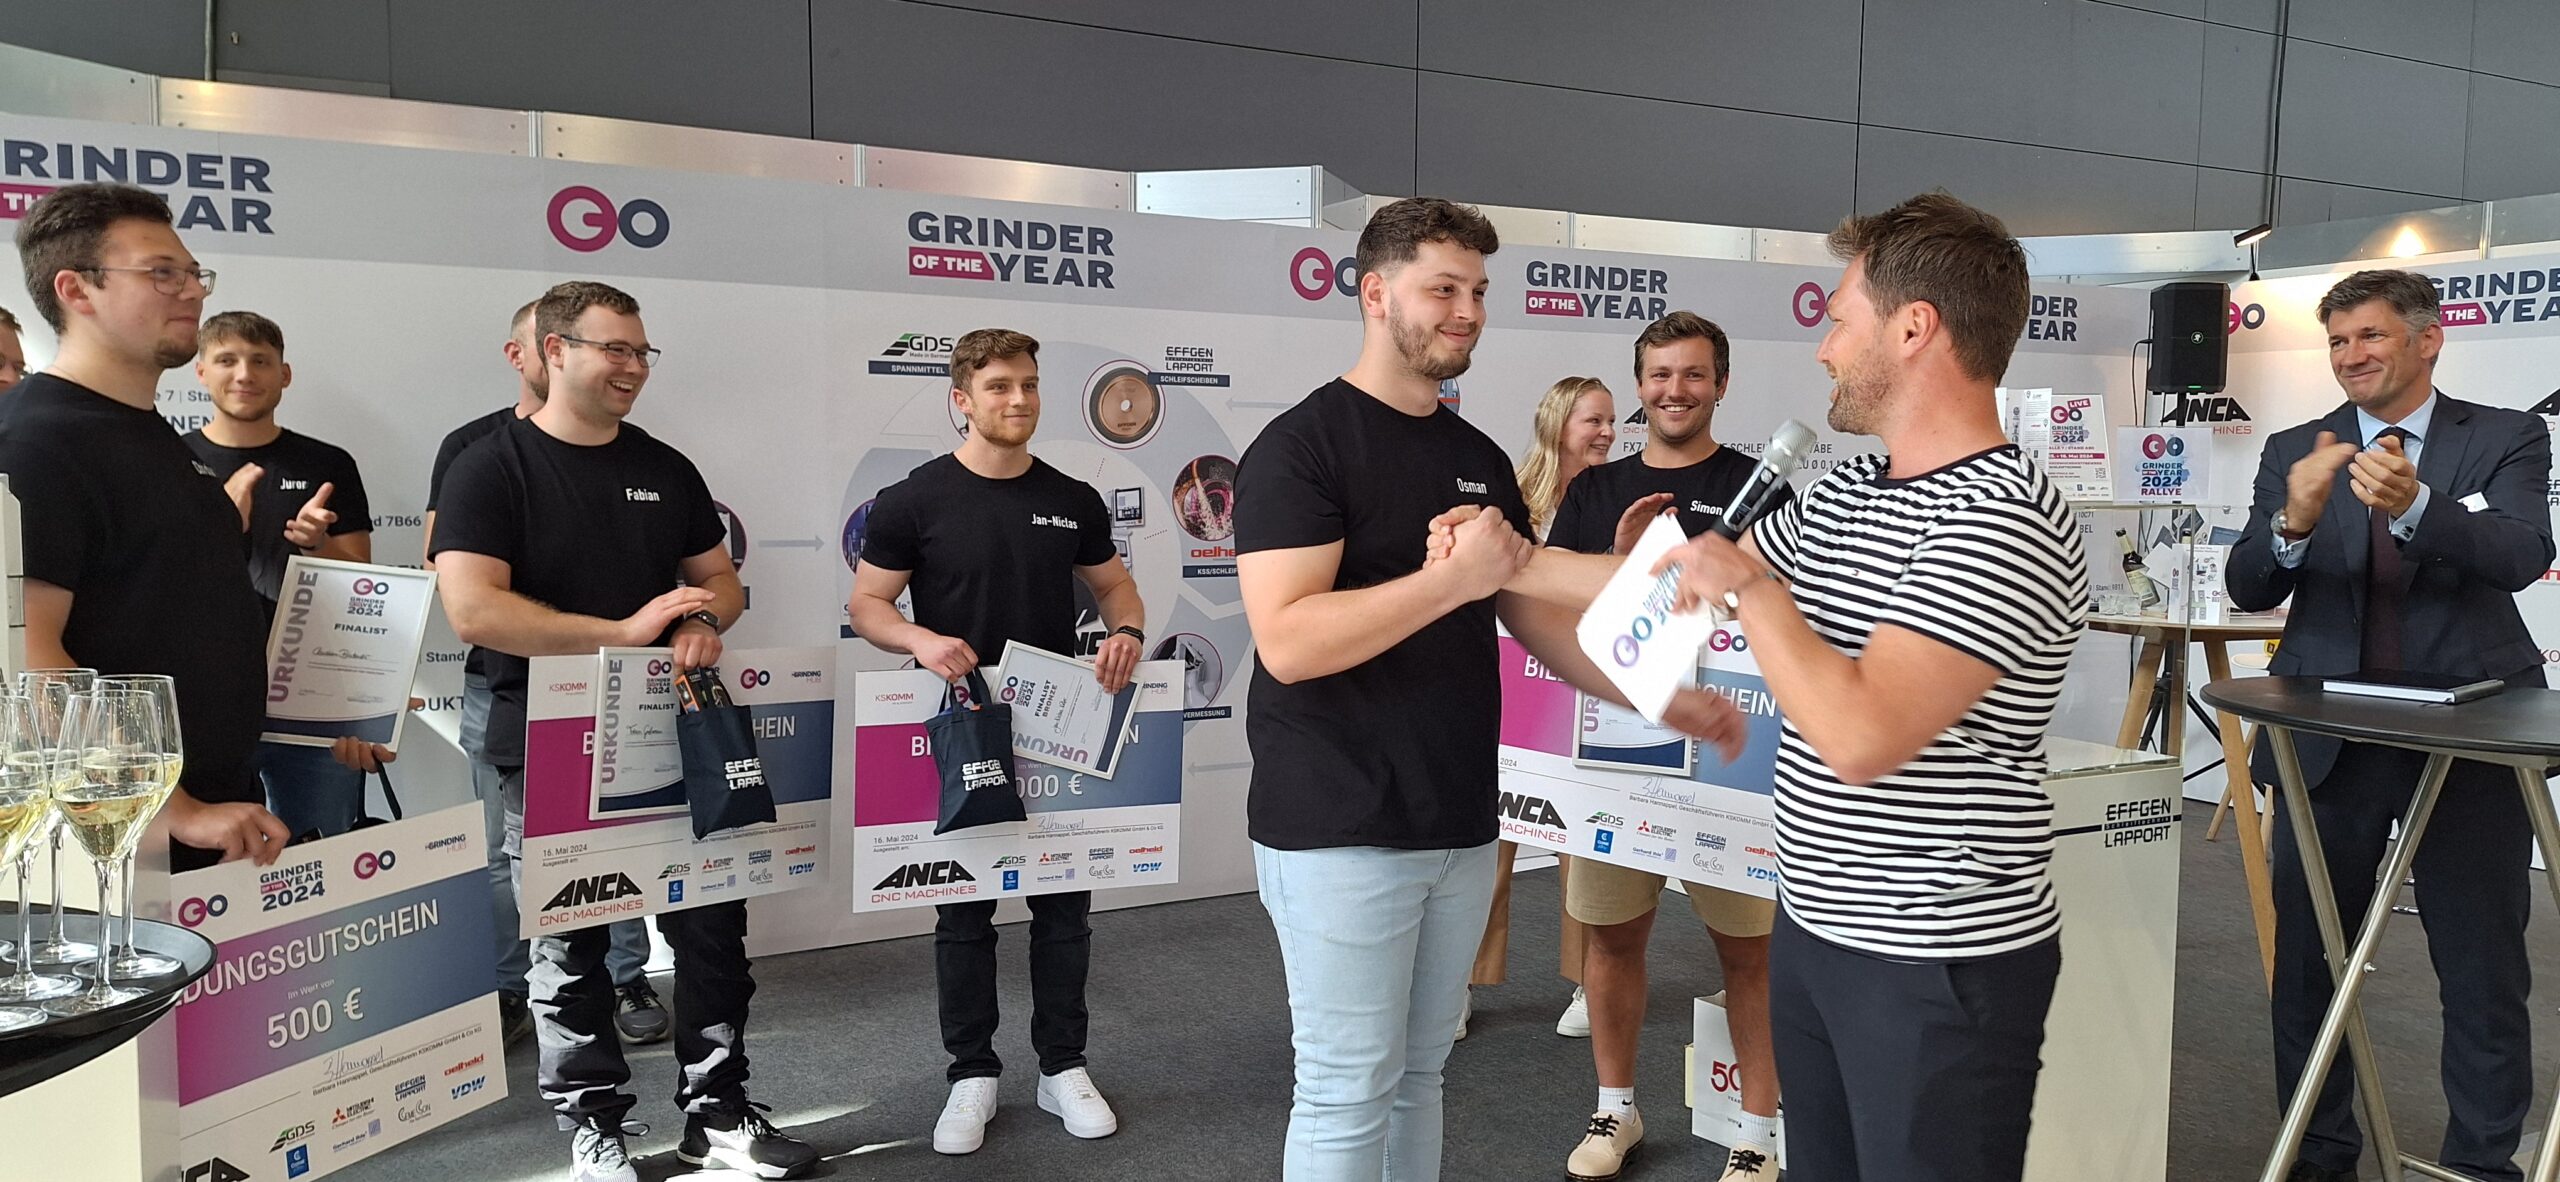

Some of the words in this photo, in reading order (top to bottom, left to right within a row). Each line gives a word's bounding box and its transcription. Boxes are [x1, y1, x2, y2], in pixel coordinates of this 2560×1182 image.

[547, 186, 670, 252] GO
[908, 211, 1115, 256] GRINDER
[912, 255, 940, 269] OF
[944, 256, 983, 272] THE
[990, 253, 1115, 289] YEAR
[1526, 260, 1668, 294] GRINDER
[1528, 296, 1548, 310] OF
[1549, 297, 1576, 311] THE
[1582, 294, 1667, 320] YEAR
[2445, 309, 2477, 321] THE
[909, 336, 954, 352] GDS
[1166, 346, 1213, 357] EFFGEN
[891, 365, 945, 373] SPANNMITTEL
[1166, 362, 1213, 372] LAPPORT
[1160, 376, 1218, 384] SCHLEIFSCHEIBEN
[2070, 400, 2088, 408] LIVE
[2051, 406, 2082, 424] GO
[2142, 434, 2184, 459] GO
[280, 477, 308, 490] Juror
[1457, 478, 1487, 495] Osman
[2141, 476, 2182, 487] 2024
[625, 488, 660, 501] Fabian
[2141, 488, 2182, 496] RALLYE
[1690, 500, 1723, 516] Simon
[385, 515, 422, 527] 7B66
[1031, 513, 1078, 530] Jan-Niclas
[353, 578, 389, 596] GO
[347, 606, 383, 617] 2024
[268, 571, 319, 703] URKUNDE
[334, 623, 388, 635] FINALIST
[1709, 629, 1748, 652] GO
[426, 651, 465, 663] Stand
[647, 659, 672, 676] GO
[549, 682, 587, 692] KSKOMM
[741, 669, 770, 689] GO
[646, 686, 670, 694] 2024
[875, 693, 914, 702] KSKOMM
[1023, 682, 1036, 707] 2024
[1035, 680, 1051, 717] FINALIST
[639, 703, 675, 711] FINALIST
[1042, 684, 1057, 717] BRONZE
[602, 660, 622, 783] URKUNDE
[1012, 732, 1088, 764] URKUN
[1500, 758, 1517, 767] 2024
[1068, 773, 1083, 795] €
[1498, 790, 1567, 830] NCA
[1629, 794, 1649, 804] Barbara
[1752, 819, 1768, 828] GmbH
[2105, 797, 2171, 821] EFFGEN
[1600, 814, 1624, 826] GDS
[428, 834, 466, 850] GRINDING
[1696, 832, 1726, 843] EFFGEN
[2105, 826, 2171, 848] LAPPORT
[570, 844, 587, 854] 2024
[1129, 846, 1163, 854] oelheld
[1695, 841, 1725, 852] LAPPORT
[353, 850, 396, 880] GO
[671, 863, 691, 873] GDS
[1003, 855, 1027, 864] GDS
[1133, 862, 1163, 872] VDW
[260, 860, 322, 883] GRINDER
[788, 862, 815, 875] VDW
[872, 860, 976, 890] ANCA
[286, 870, 323, 887] YEAR
[262, 881, 325, 911] 2024
[541, 872, 643, 912] ANCA
[872, 892, 900, 903] CNC
[905, 885, 976, 899] MACHINES
[178, 894, 228, 928] GO
[540, 912, 569, 926] CNC
[573, 899, 644, 921] MACHINES
[176, 899, 439, 1007] DUNGSGUTSCHEIN
[288, 990, 298, 1000] Im
[300, 984, 319, 997] Wert
[320, 978, 335, 988] von
[268, 999, 332, 1049] 500
[343, 987, 364, 1020] €
[444, 1054, 484, 1076] oelheld
[395, 1074, 426, 1091] EFFGEN
[451, 1076, 486, 1100] VDW
[395, 1085, 426, 1101] LAPPORT
[286, 1121, 315, 1141] GDS
